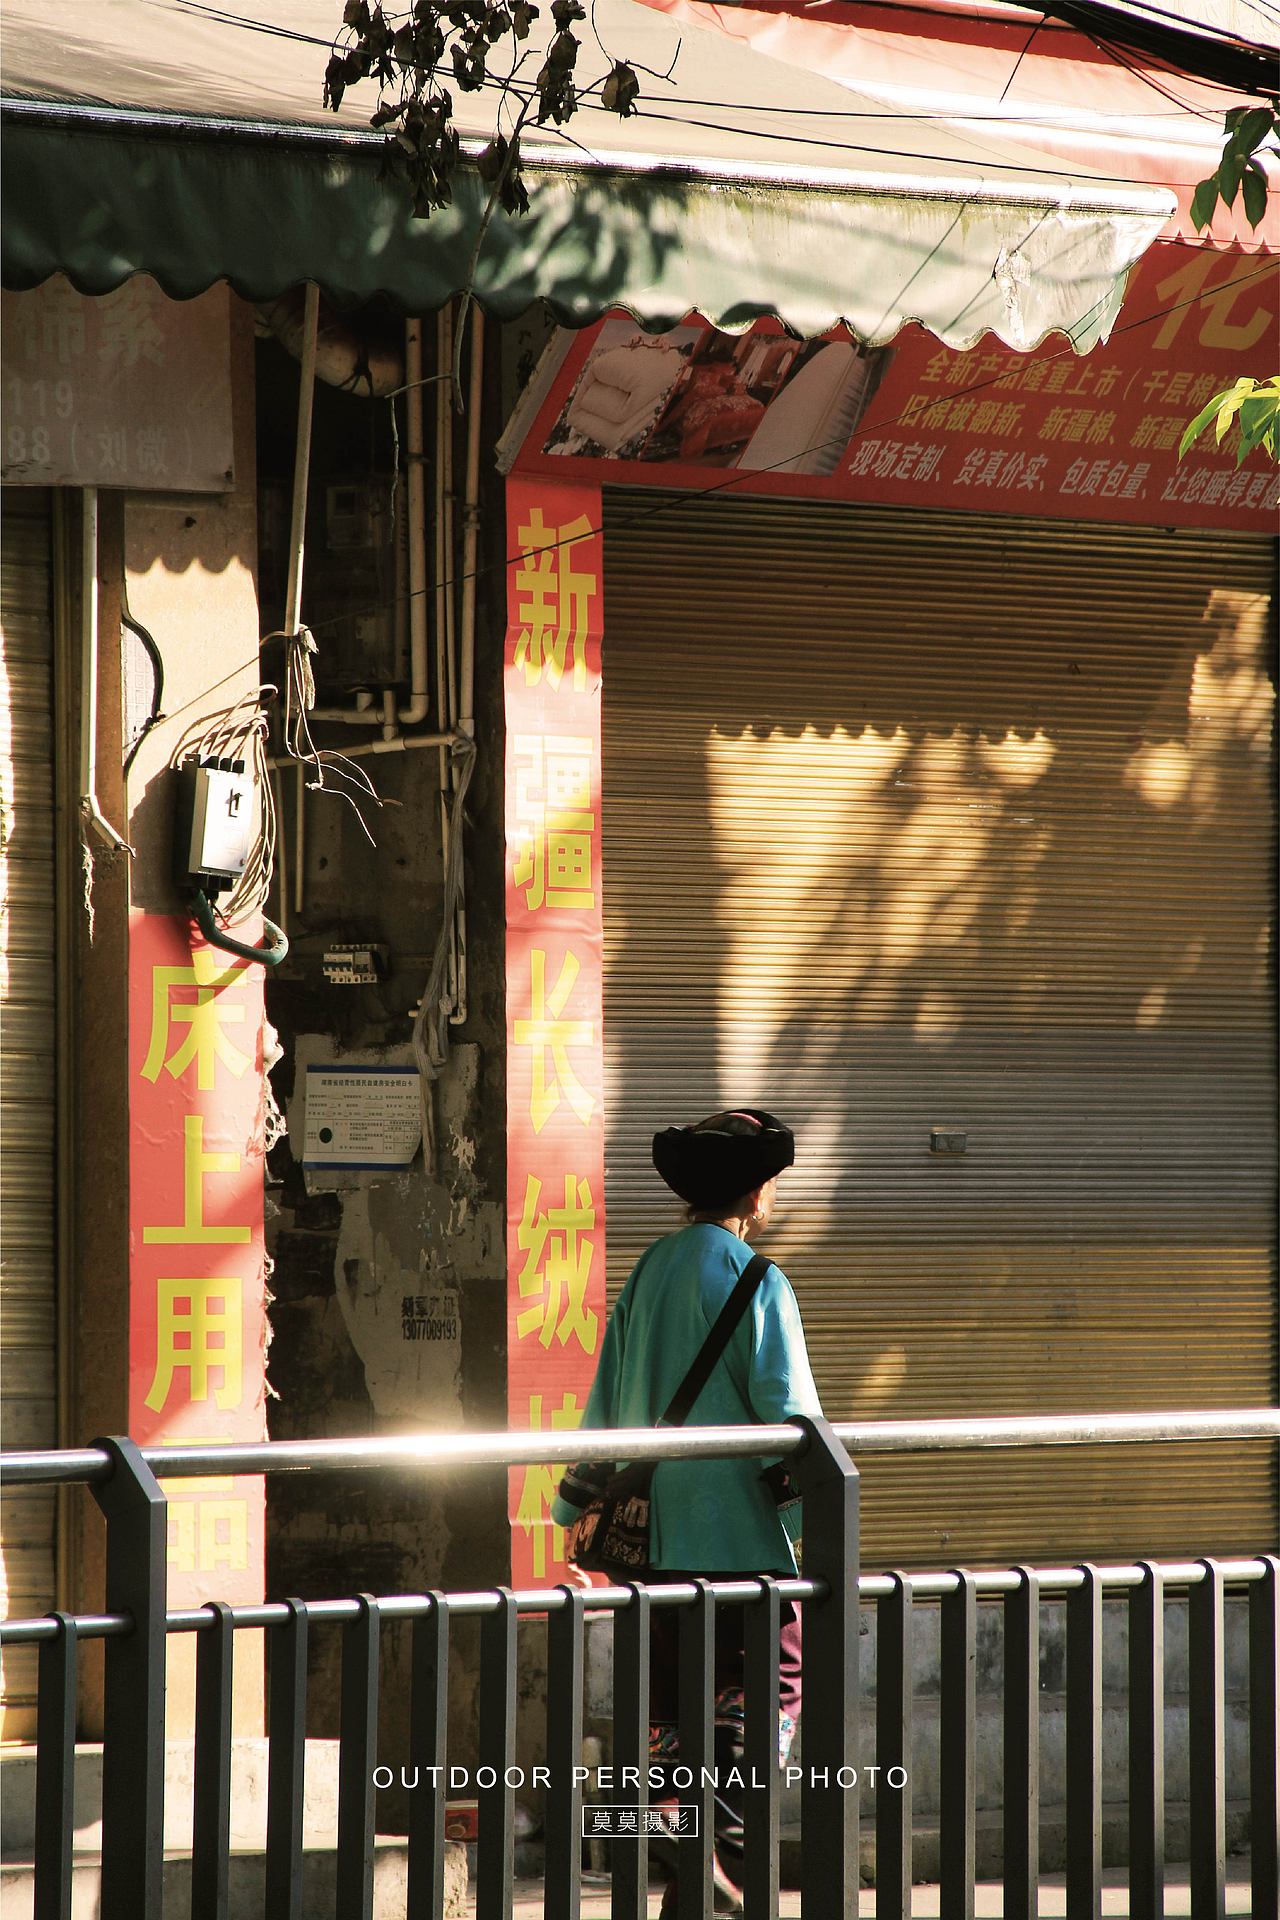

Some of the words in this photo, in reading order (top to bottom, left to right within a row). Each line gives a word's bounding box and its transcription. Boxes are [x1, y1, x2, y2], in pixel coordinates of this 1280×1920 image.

[8, 377, 73, 418] 119
[919, 351, 1236, 406] 全新产品隆重上市（千层棉
[139, 950, 252, 1573] 床上用品
